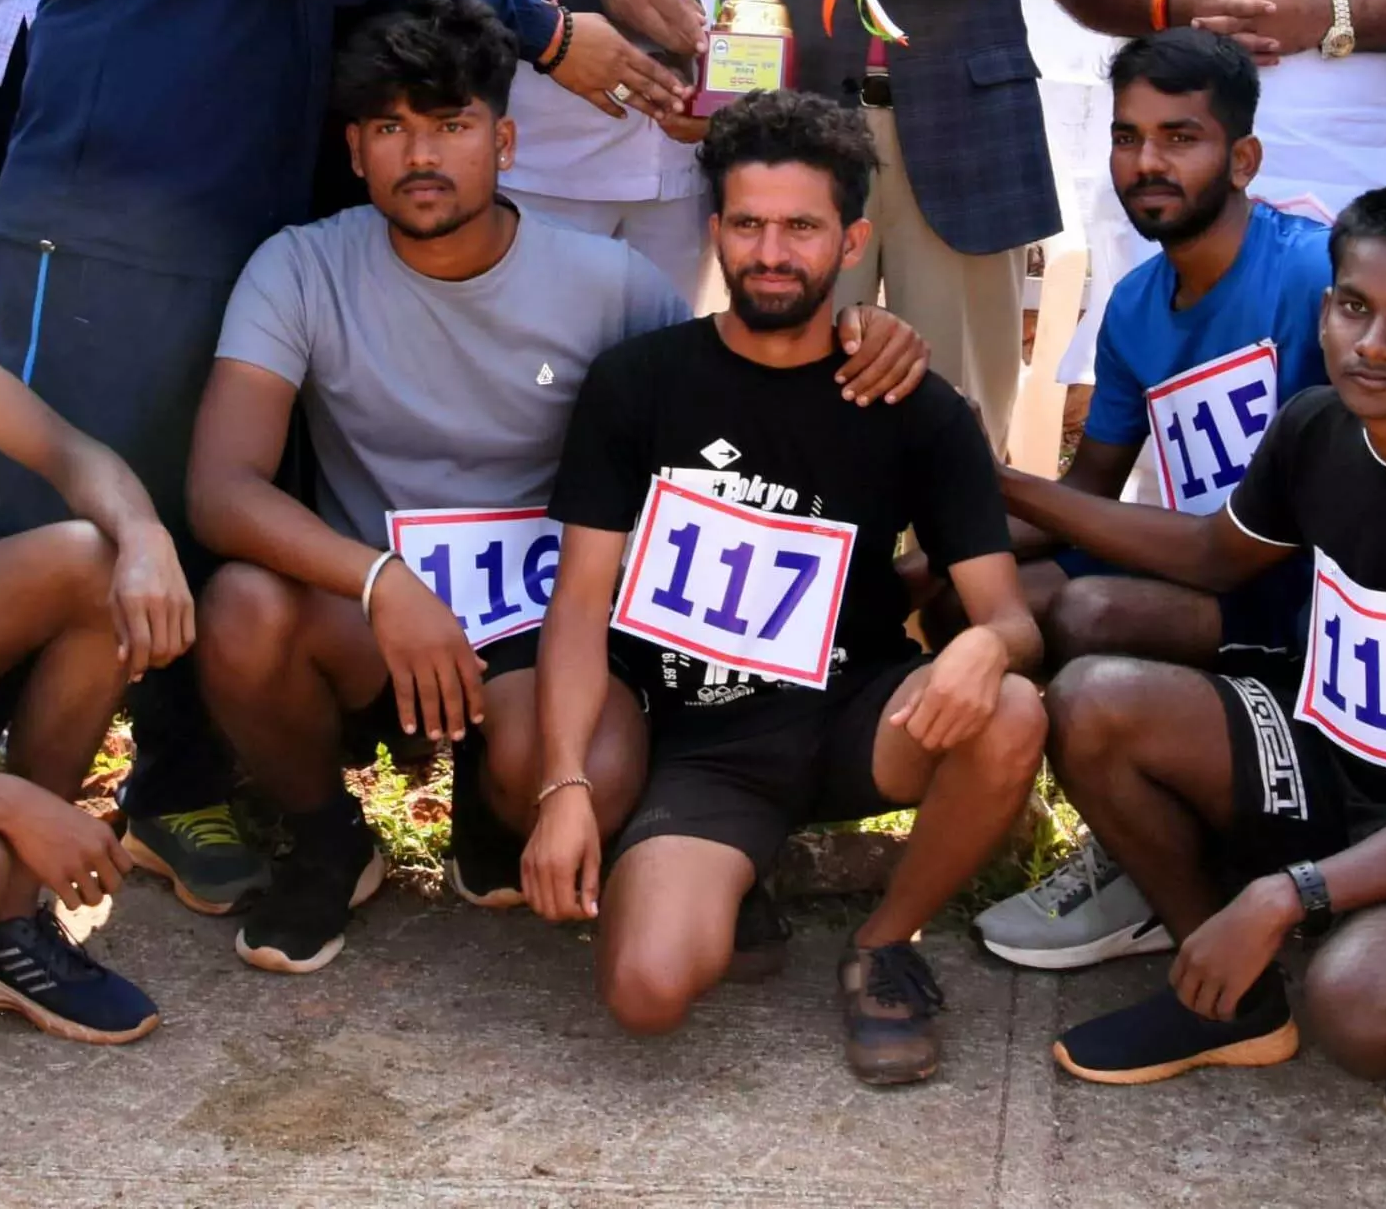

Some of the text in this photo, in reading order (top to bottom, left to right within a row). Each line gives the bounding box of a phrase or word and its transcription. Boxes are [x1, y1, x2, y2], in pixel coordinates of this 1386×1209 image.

[1167, 379, 1268, 500] 115
[420, 534, 561, 630] 116
[651, 522, 821, 641] 117
